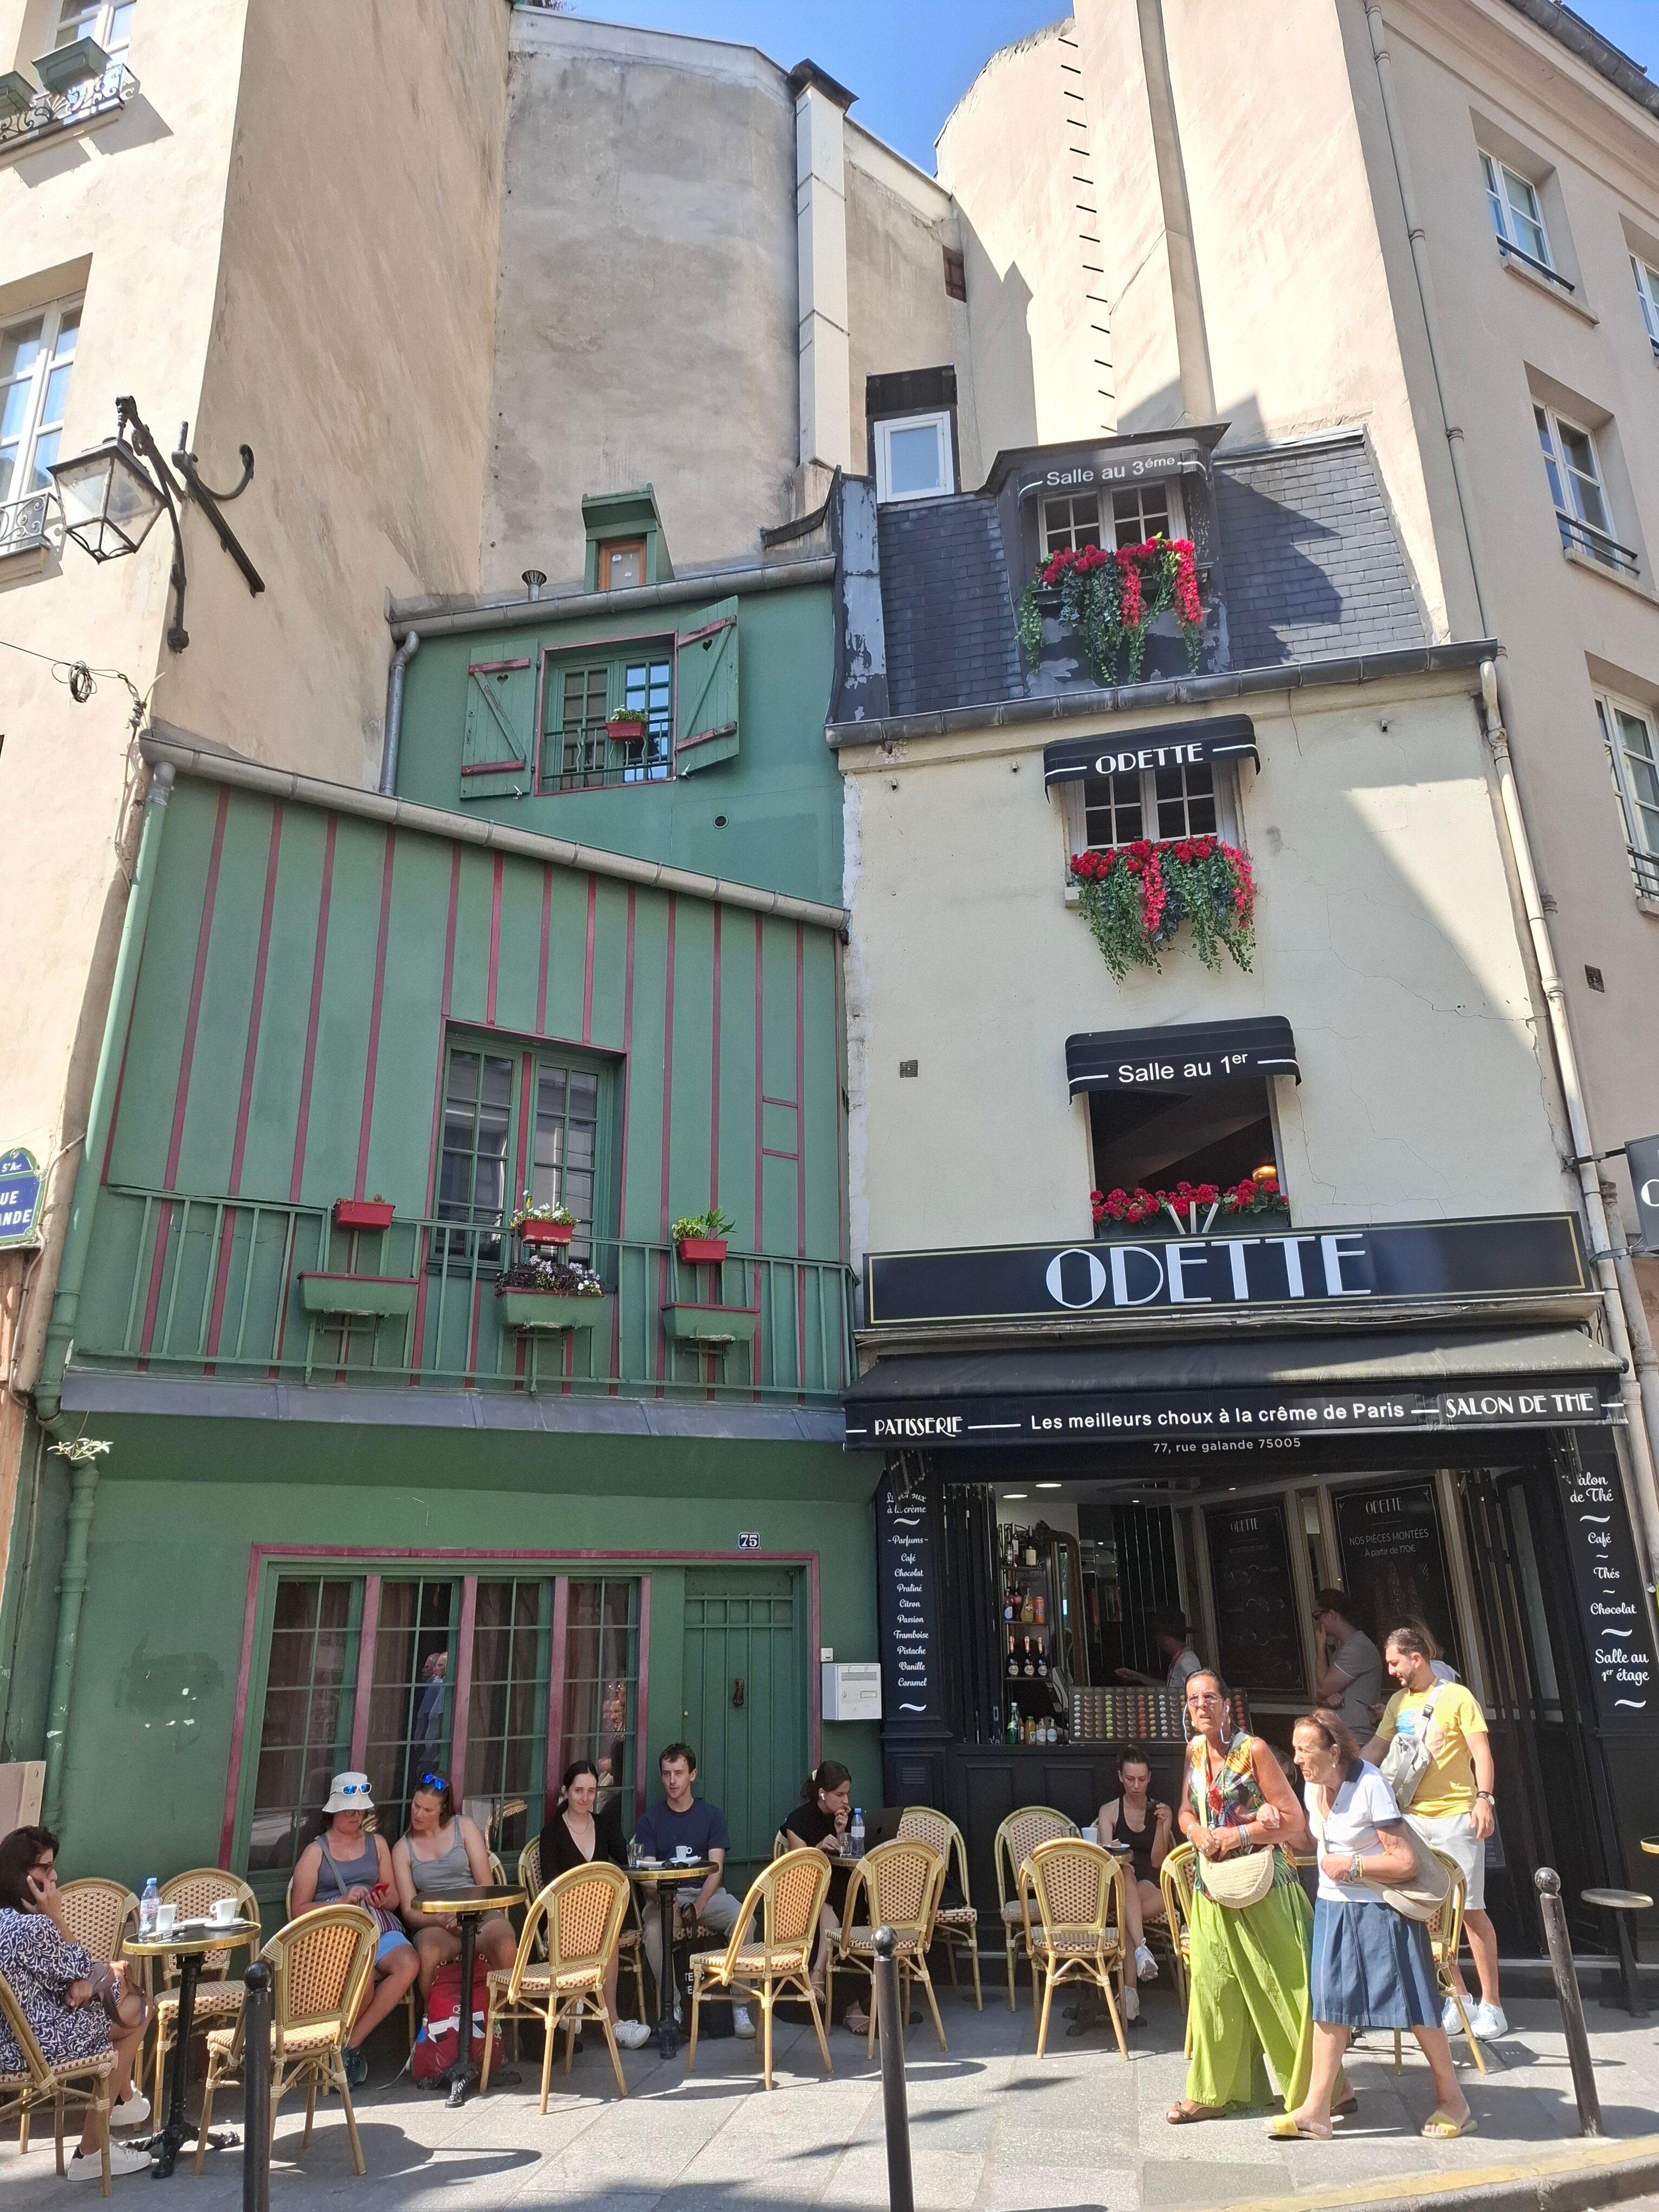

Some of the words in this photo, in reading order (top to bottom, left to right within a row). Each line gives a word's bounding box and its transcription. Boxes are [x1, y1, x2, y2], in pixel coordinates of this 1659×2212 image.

[1046, 468, 1094, 485] Salle
[1101, 465, 1125, 479] au
[1095, 742, 1203, 774] ODETTE
[1118, 1062, 1174, 1083] Salle
[1183, 1061, 1211, 1077] au
[1220, 1052, 1248, 1073] 1er
[0, 1191, 19, 1205] UE
[1045, 1233, 1372, 1309] ODETTE
[874, 1416, 963, 1437] PATISSERIE
[1031, 1415, 1062, 1429] Les
[1068, 1412, 1152, 1428] meilleurs
[1158, 1410, 1213, 1425] choux
[1218, 1409, 1230, 1423] à
[1236, 1407, 1252, 1422] la
[1258, 1406, 1317, 1421] crême
[1323, 1404, 1347, 1419] de
[1353, 1402, 1404, 1418] Paris
[1446, 1396, 1513, 1418] SALON
[1519, 1394, 1547, 1413] DE
[1551, 1393, 1593, 1412] THE
[1153, 1443, 1171, 1454] 77,
[1175, 1444, 1196, 1452] rue
[1201, 1439, 1253, 1454] galande
[1258, 1437, 1301, 1449] 75005
[1578, 1471, 1608, 1486] alon
[1570, 1489, 1585, 1502] de
[1585, 1488, 1613, 1502] Thé
[886, 1504, 893, 1513] à
[903, 1504, 926, 1513] crème
[741, 1534, 757, 1546] 75
[1349, 1536, 1364, 1545] NOS
[1366, 1533, 1391, 1544] PIÈCES
[1392, 1528, 1429, 1540] MONTÉES
[1587, 1532, 1611, 1547] Café
[1390, 1546, 1398, 1554] de
[901, 1553, 916, 1564] Café
[894, 1568, 923, 1577] Chocolat
[1593, 1567, 1619, 1579] Thés
[897, 1583, 922, 1593] Praliné
[899, 1599, 920, 1608] Citron
[1590, 1602, 1636, 1615] Chocolat
[897, 1615, 924, 1624] Passion
[893, 1630, 928, 1639] Framboise
[897, 1645, 925, 1655] Pistache
[1594, 1648, 1629, 1663] Salle
[1630, 1653, 1649, 1663] au
[898, 1661, 925, 1671] Vanille
[898, 1677, 927, 1687] Caramel
[1601, 1668, 1613, 1682] 1er
[1616, 1667, 1649, 1686] étage
